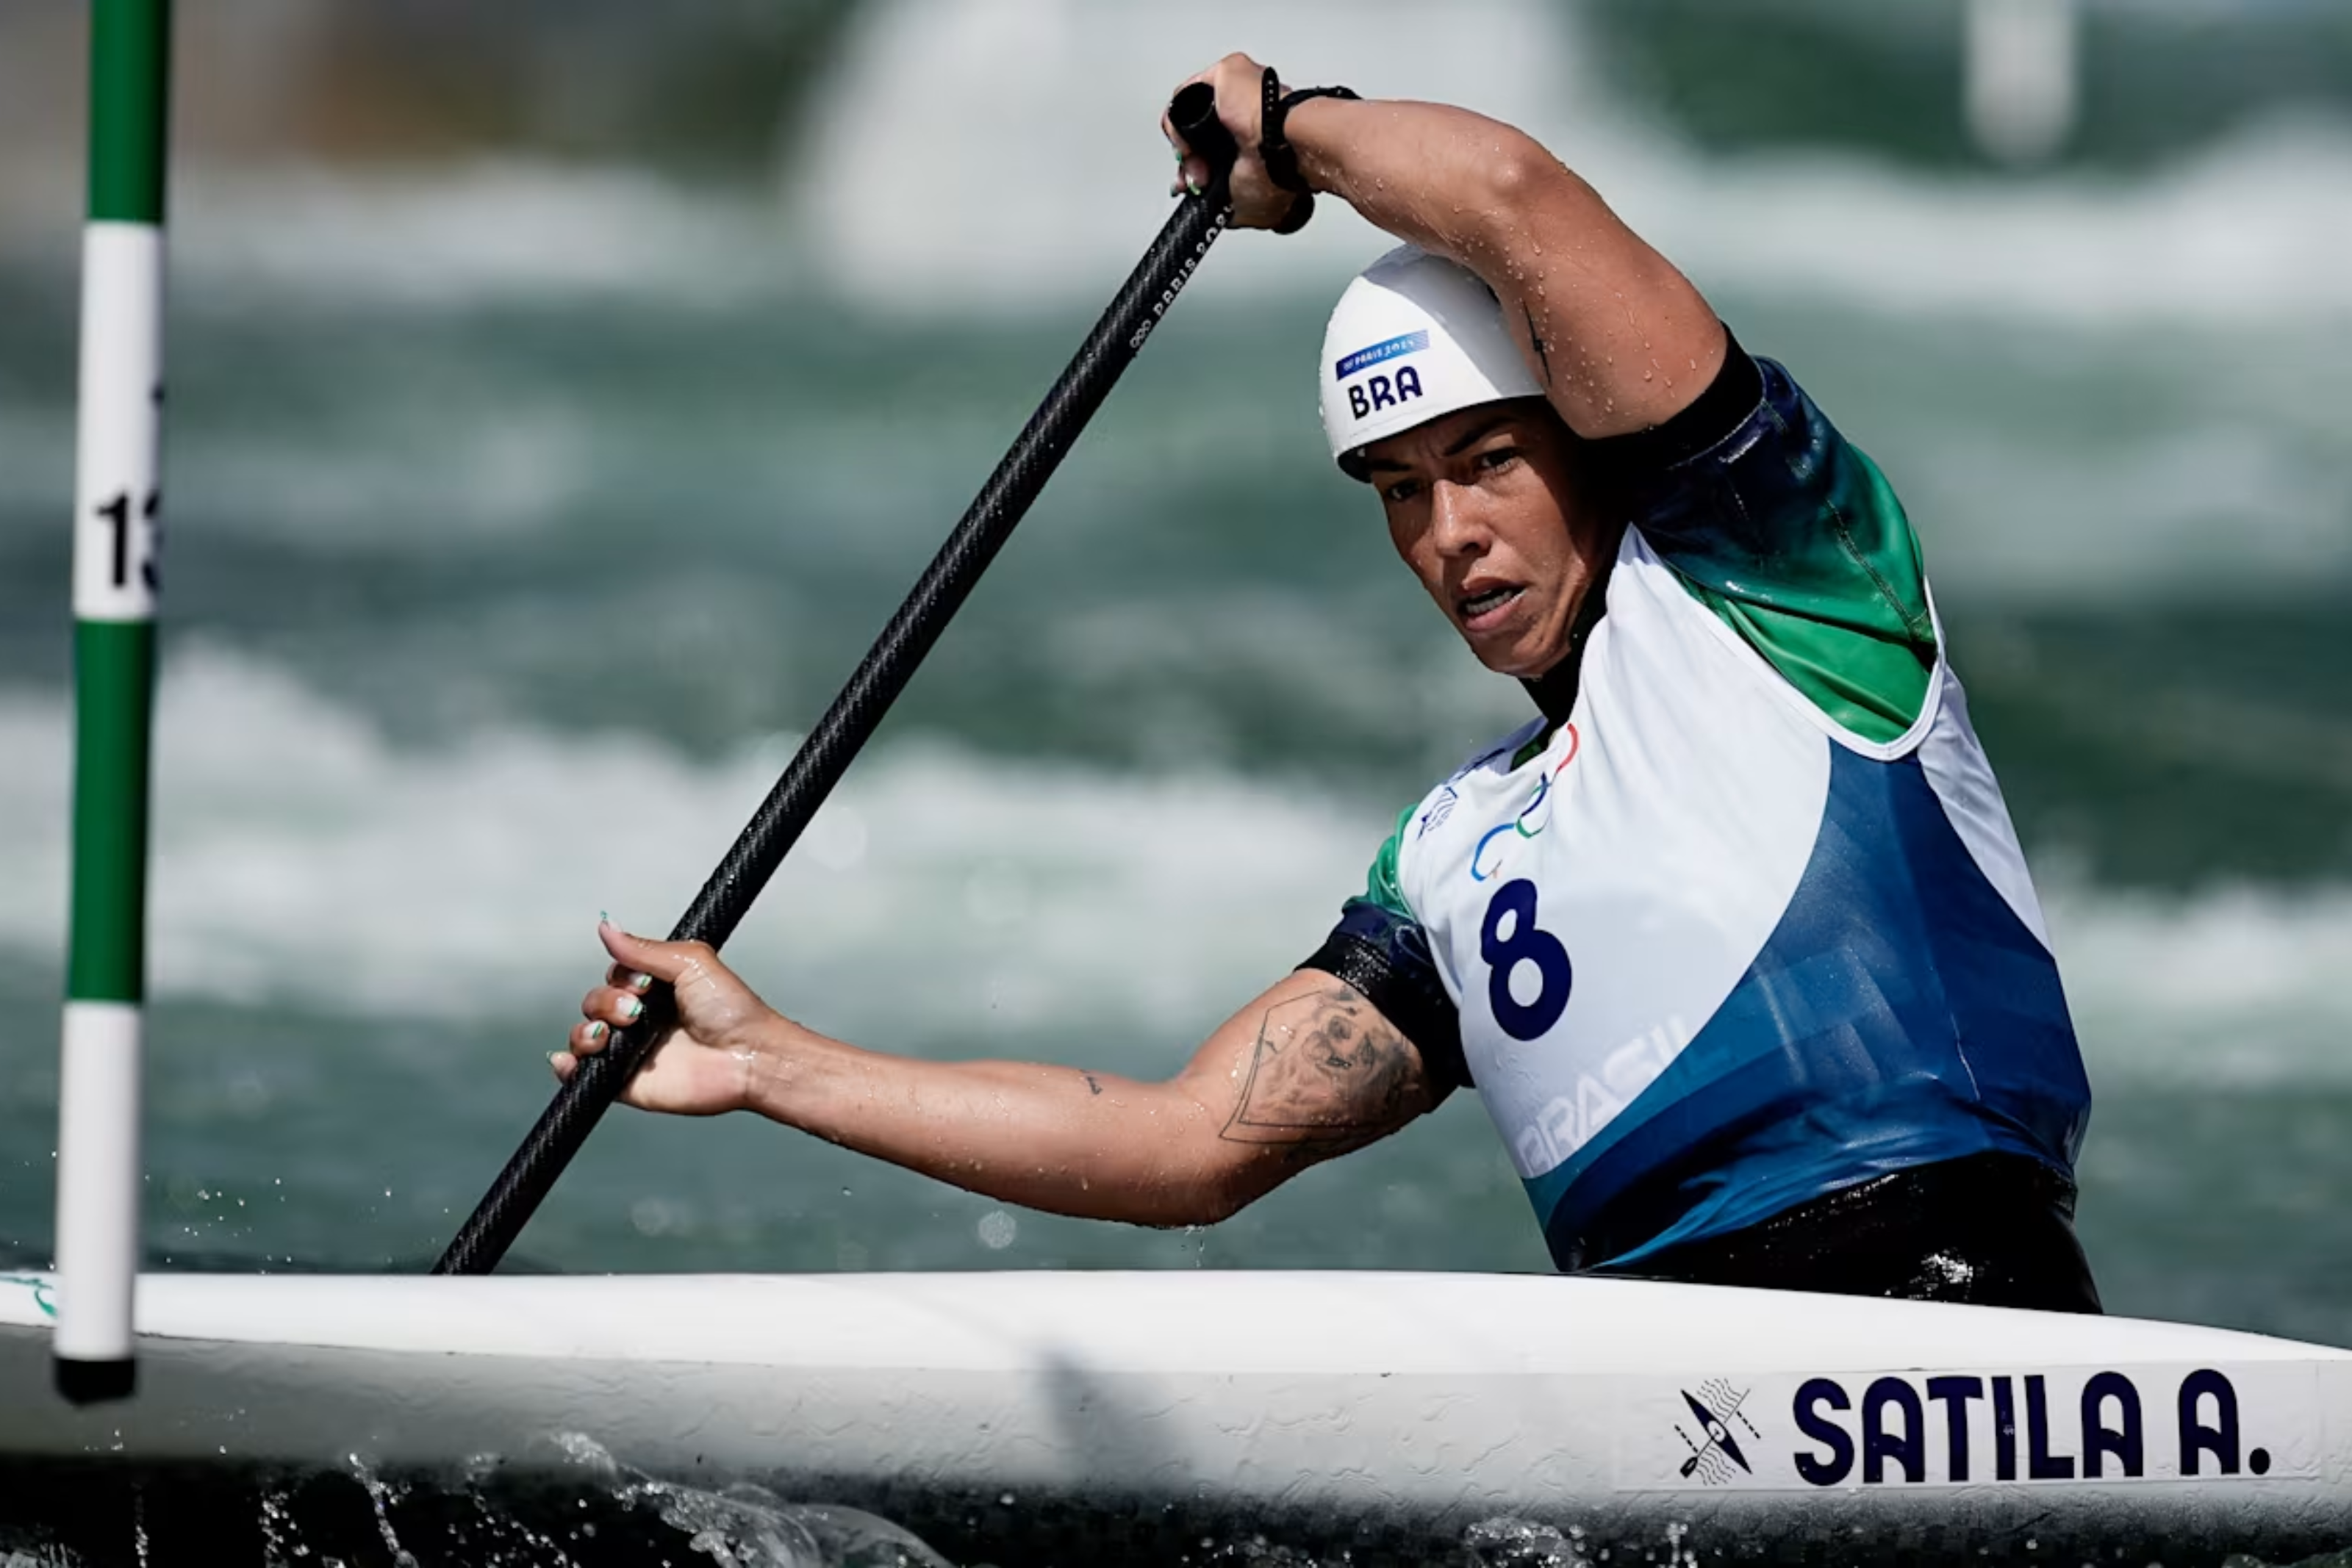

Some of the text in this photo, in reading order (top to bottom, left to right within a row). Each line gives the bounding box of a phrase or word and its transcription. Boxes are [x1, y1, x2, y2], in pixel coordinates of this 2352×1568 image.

[1153, 257, 1196, 316] PARIS
[1348, 366, 1423, 420] BRA
[1480, 877, 1573, 1041] 8
[1792, 1367, 2271, 1486] SATILA A.
